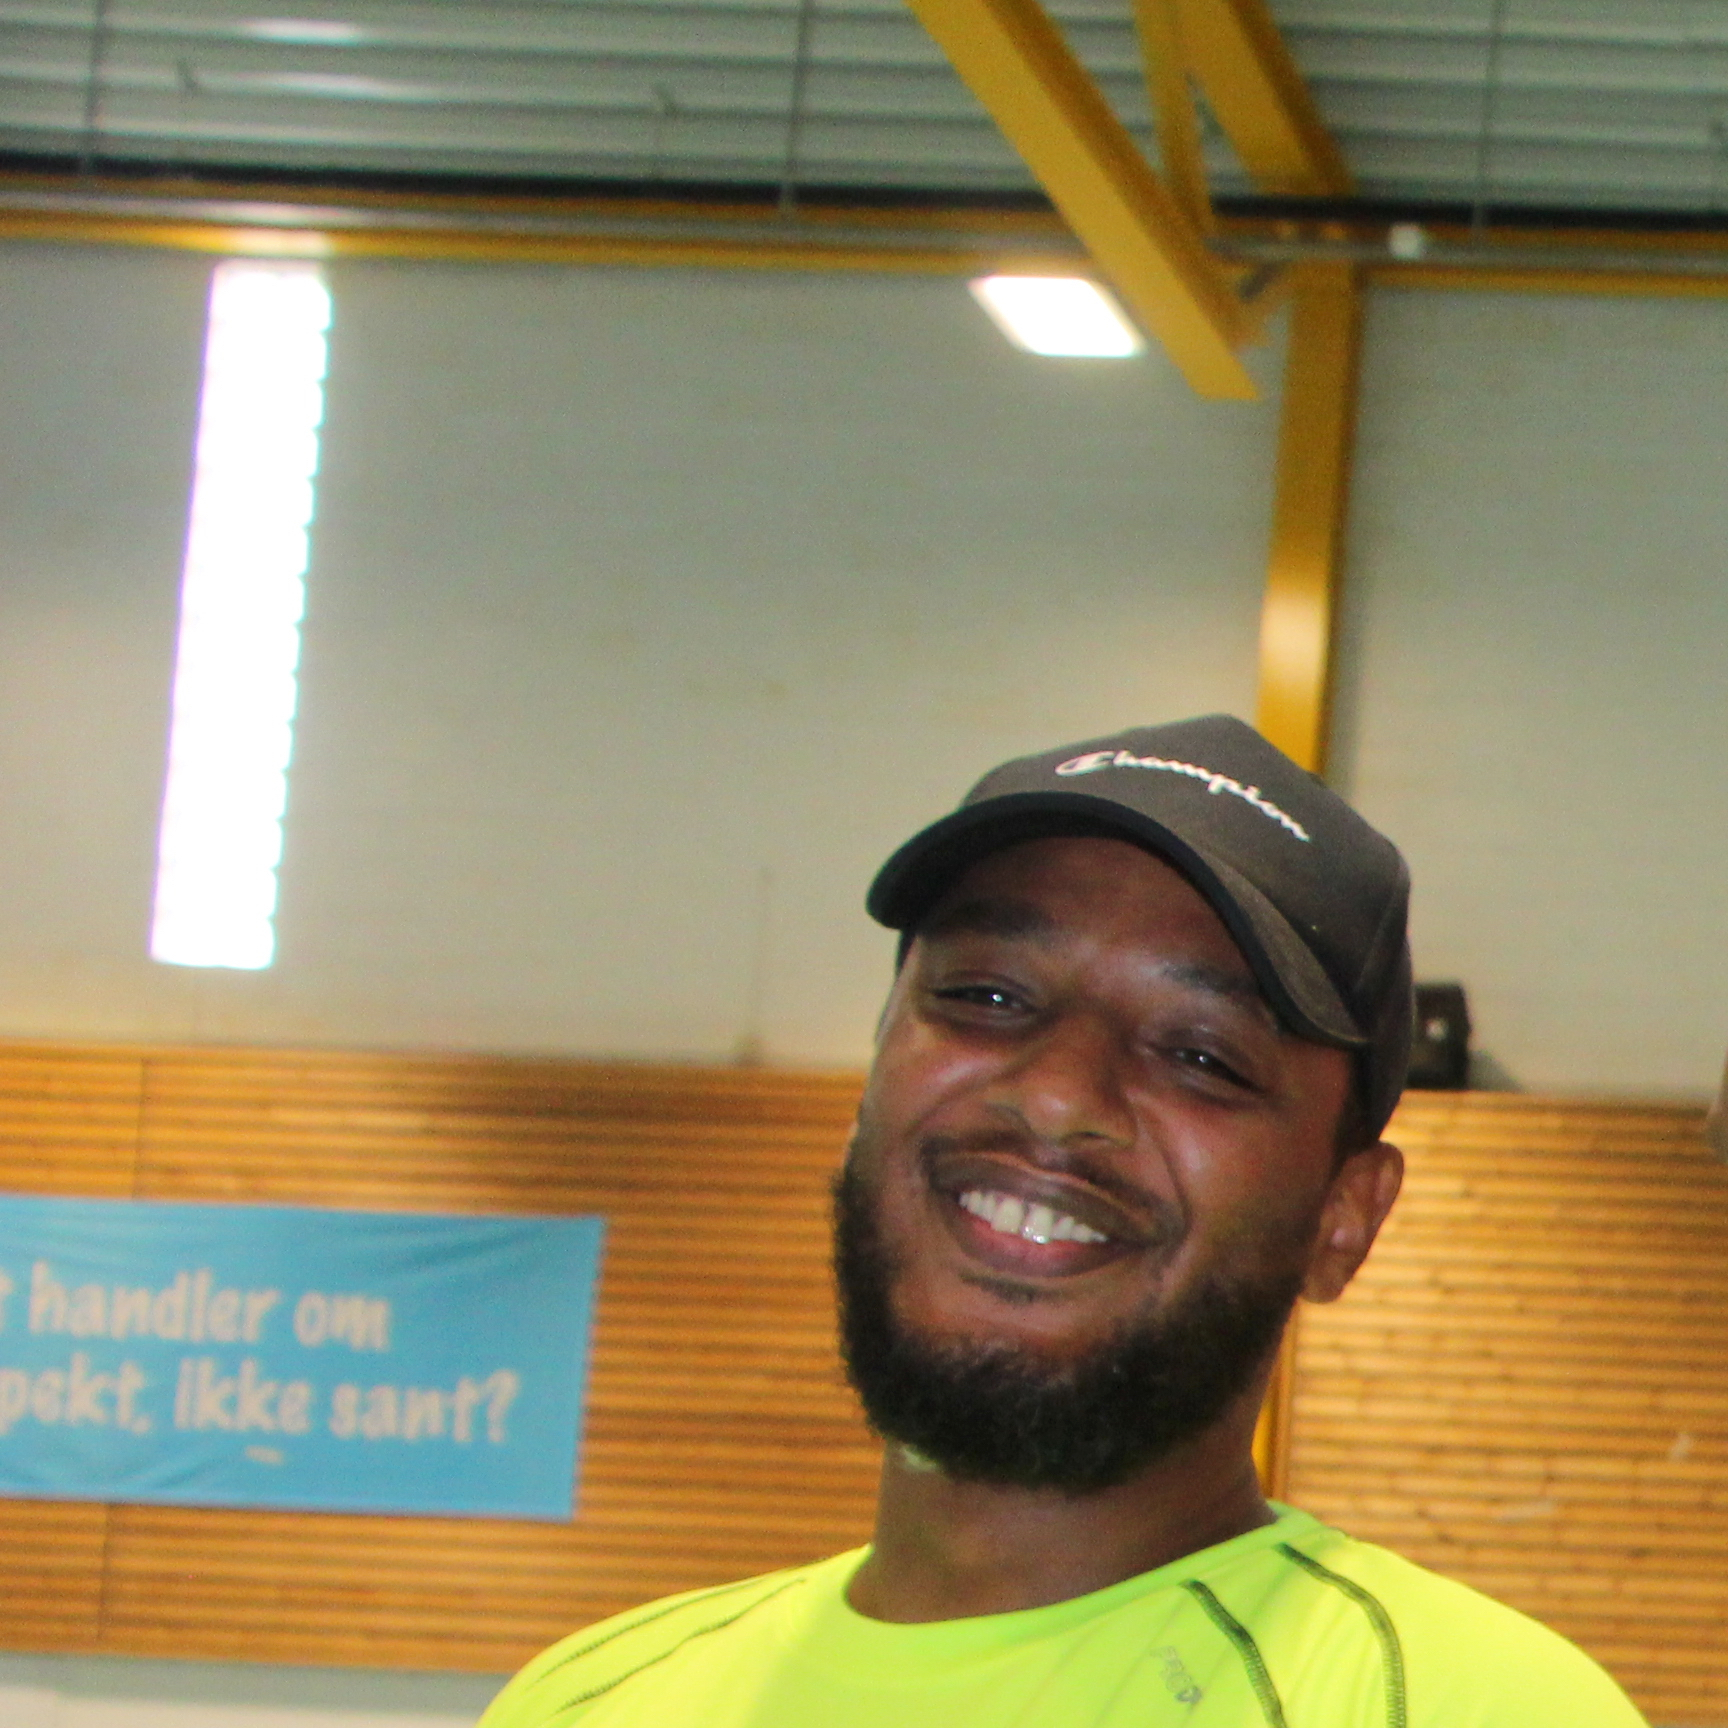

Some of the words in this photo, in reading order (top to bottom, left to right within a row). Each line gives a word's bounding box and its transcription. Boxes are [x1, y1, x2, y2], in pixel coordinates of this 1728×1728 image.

[1055, 750, 1311, 842] Champion
[30, 1261, 279, 1343] handler
[295, 1290, 391, 1352] om
[330, 1369, 519, 1443] sant?
